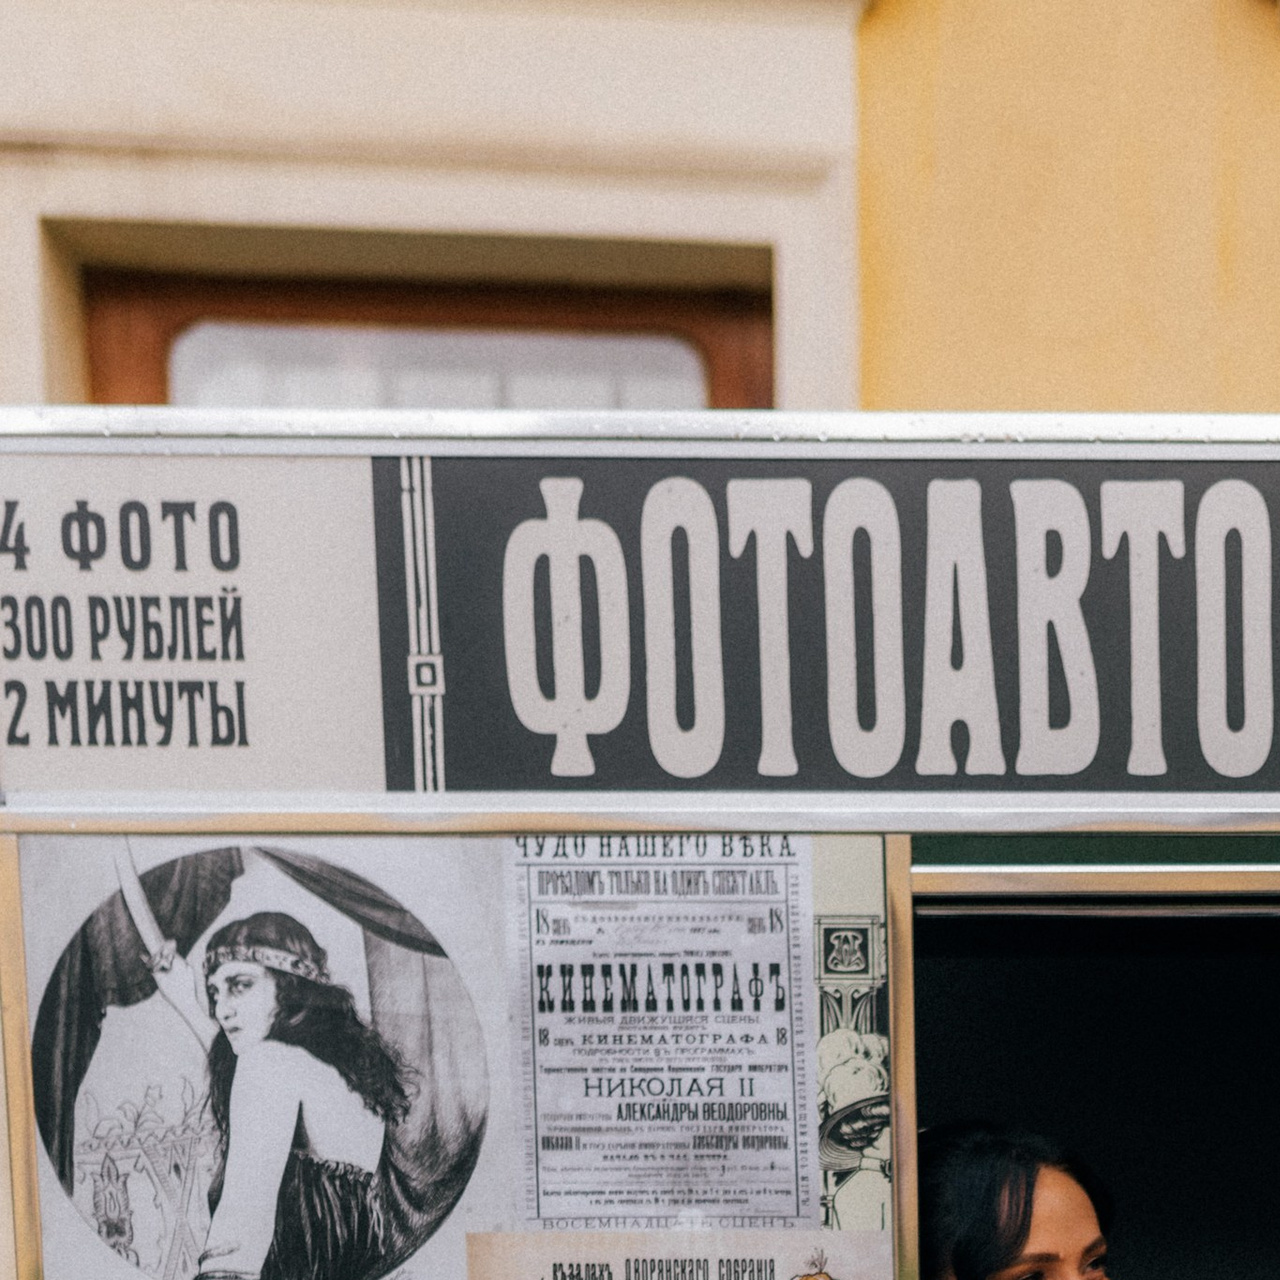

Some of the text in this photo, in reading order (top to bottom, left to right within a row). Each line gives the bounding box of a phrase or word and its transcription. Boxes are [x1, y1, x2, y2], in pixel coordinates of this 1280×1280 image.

[0, 500, 241, 572] 4 ФОТО
[2, 587, 246, 663] 300 РУБЛЕЙ
[6, 678, 250, 749] 2 МИНУТЫ
[515, 834, 586, 858] ЧУДО
[599, 834, 707, 858] НАШЕГО
[536, 908, 550, 934] 18
[769, 907, 784, 933] 18
[536, 963, 785, 1013] КИНЕМАТОГРАФЪ
[539, 1028, 788, 1047] 18 КИНЕМАТОГРАФА 18
[584, 1077, 724, 1098] НИКОЛАЯ
[617, 1103, 698, 1122] АЛЕКСАНДРЫ
